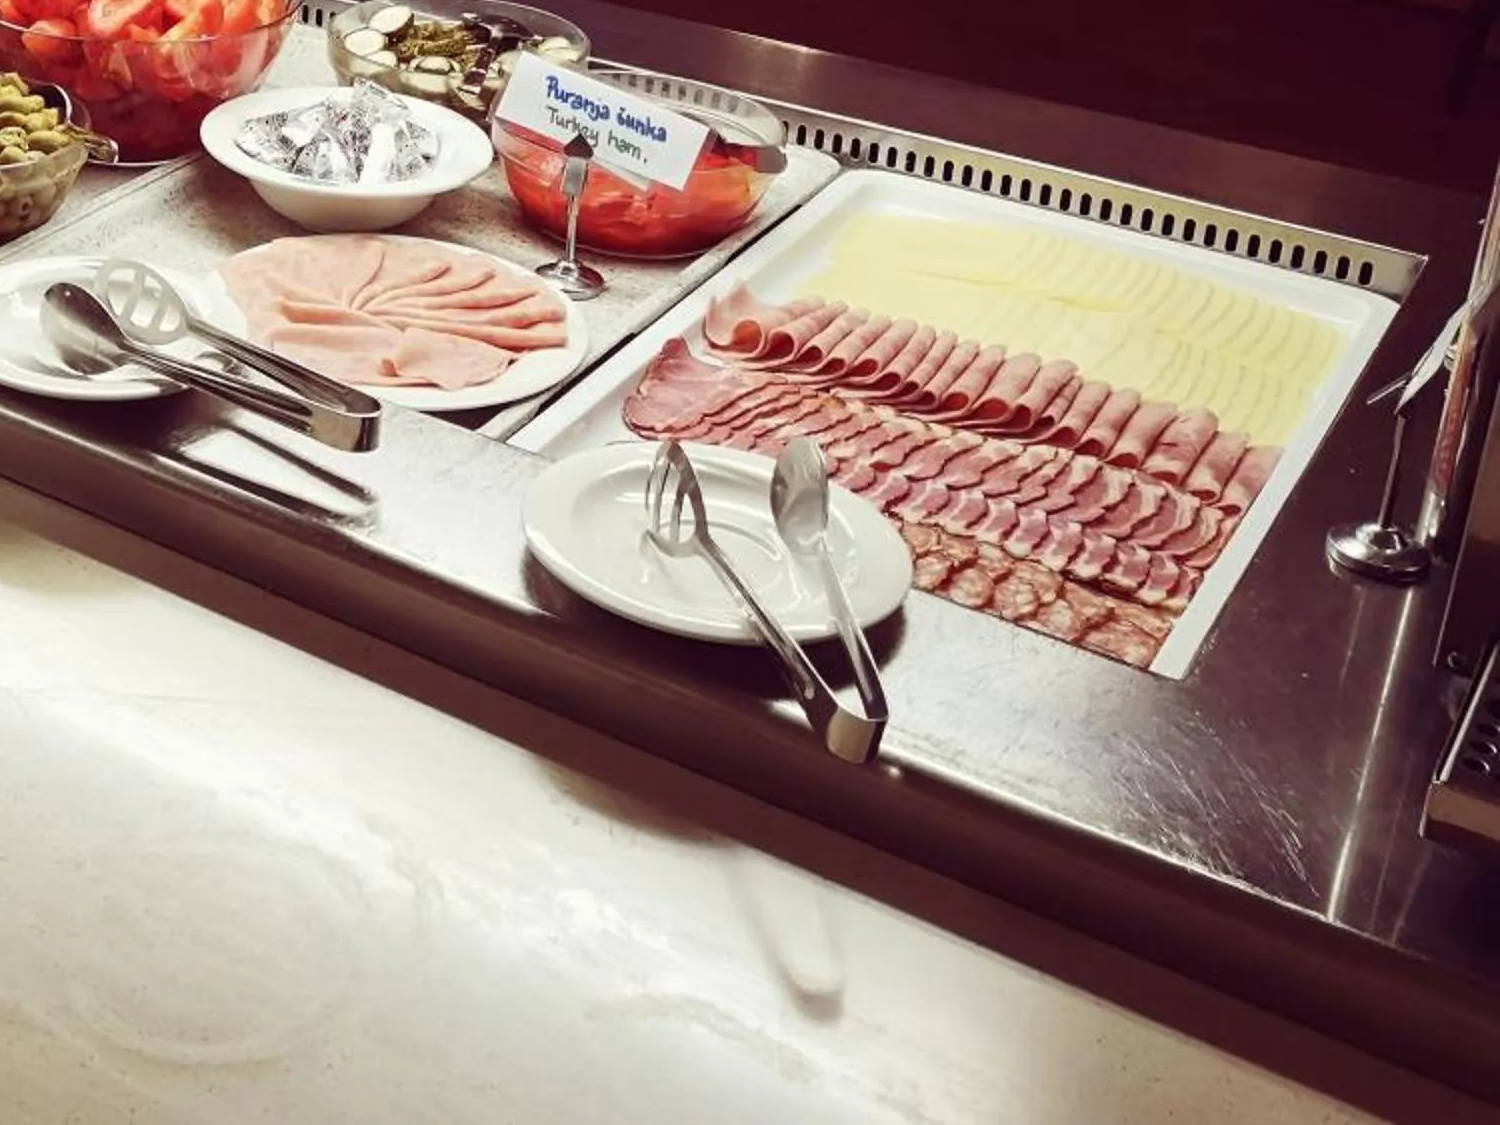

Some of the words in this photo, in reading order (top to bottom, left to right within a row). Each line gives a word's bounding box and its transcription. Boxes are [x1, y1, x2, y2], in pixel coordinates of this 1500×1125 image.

[545, 75, 611, 121] Puranja
[616, 107, 668, 142] šunka
[546, 105, 599, 148] Turkey
